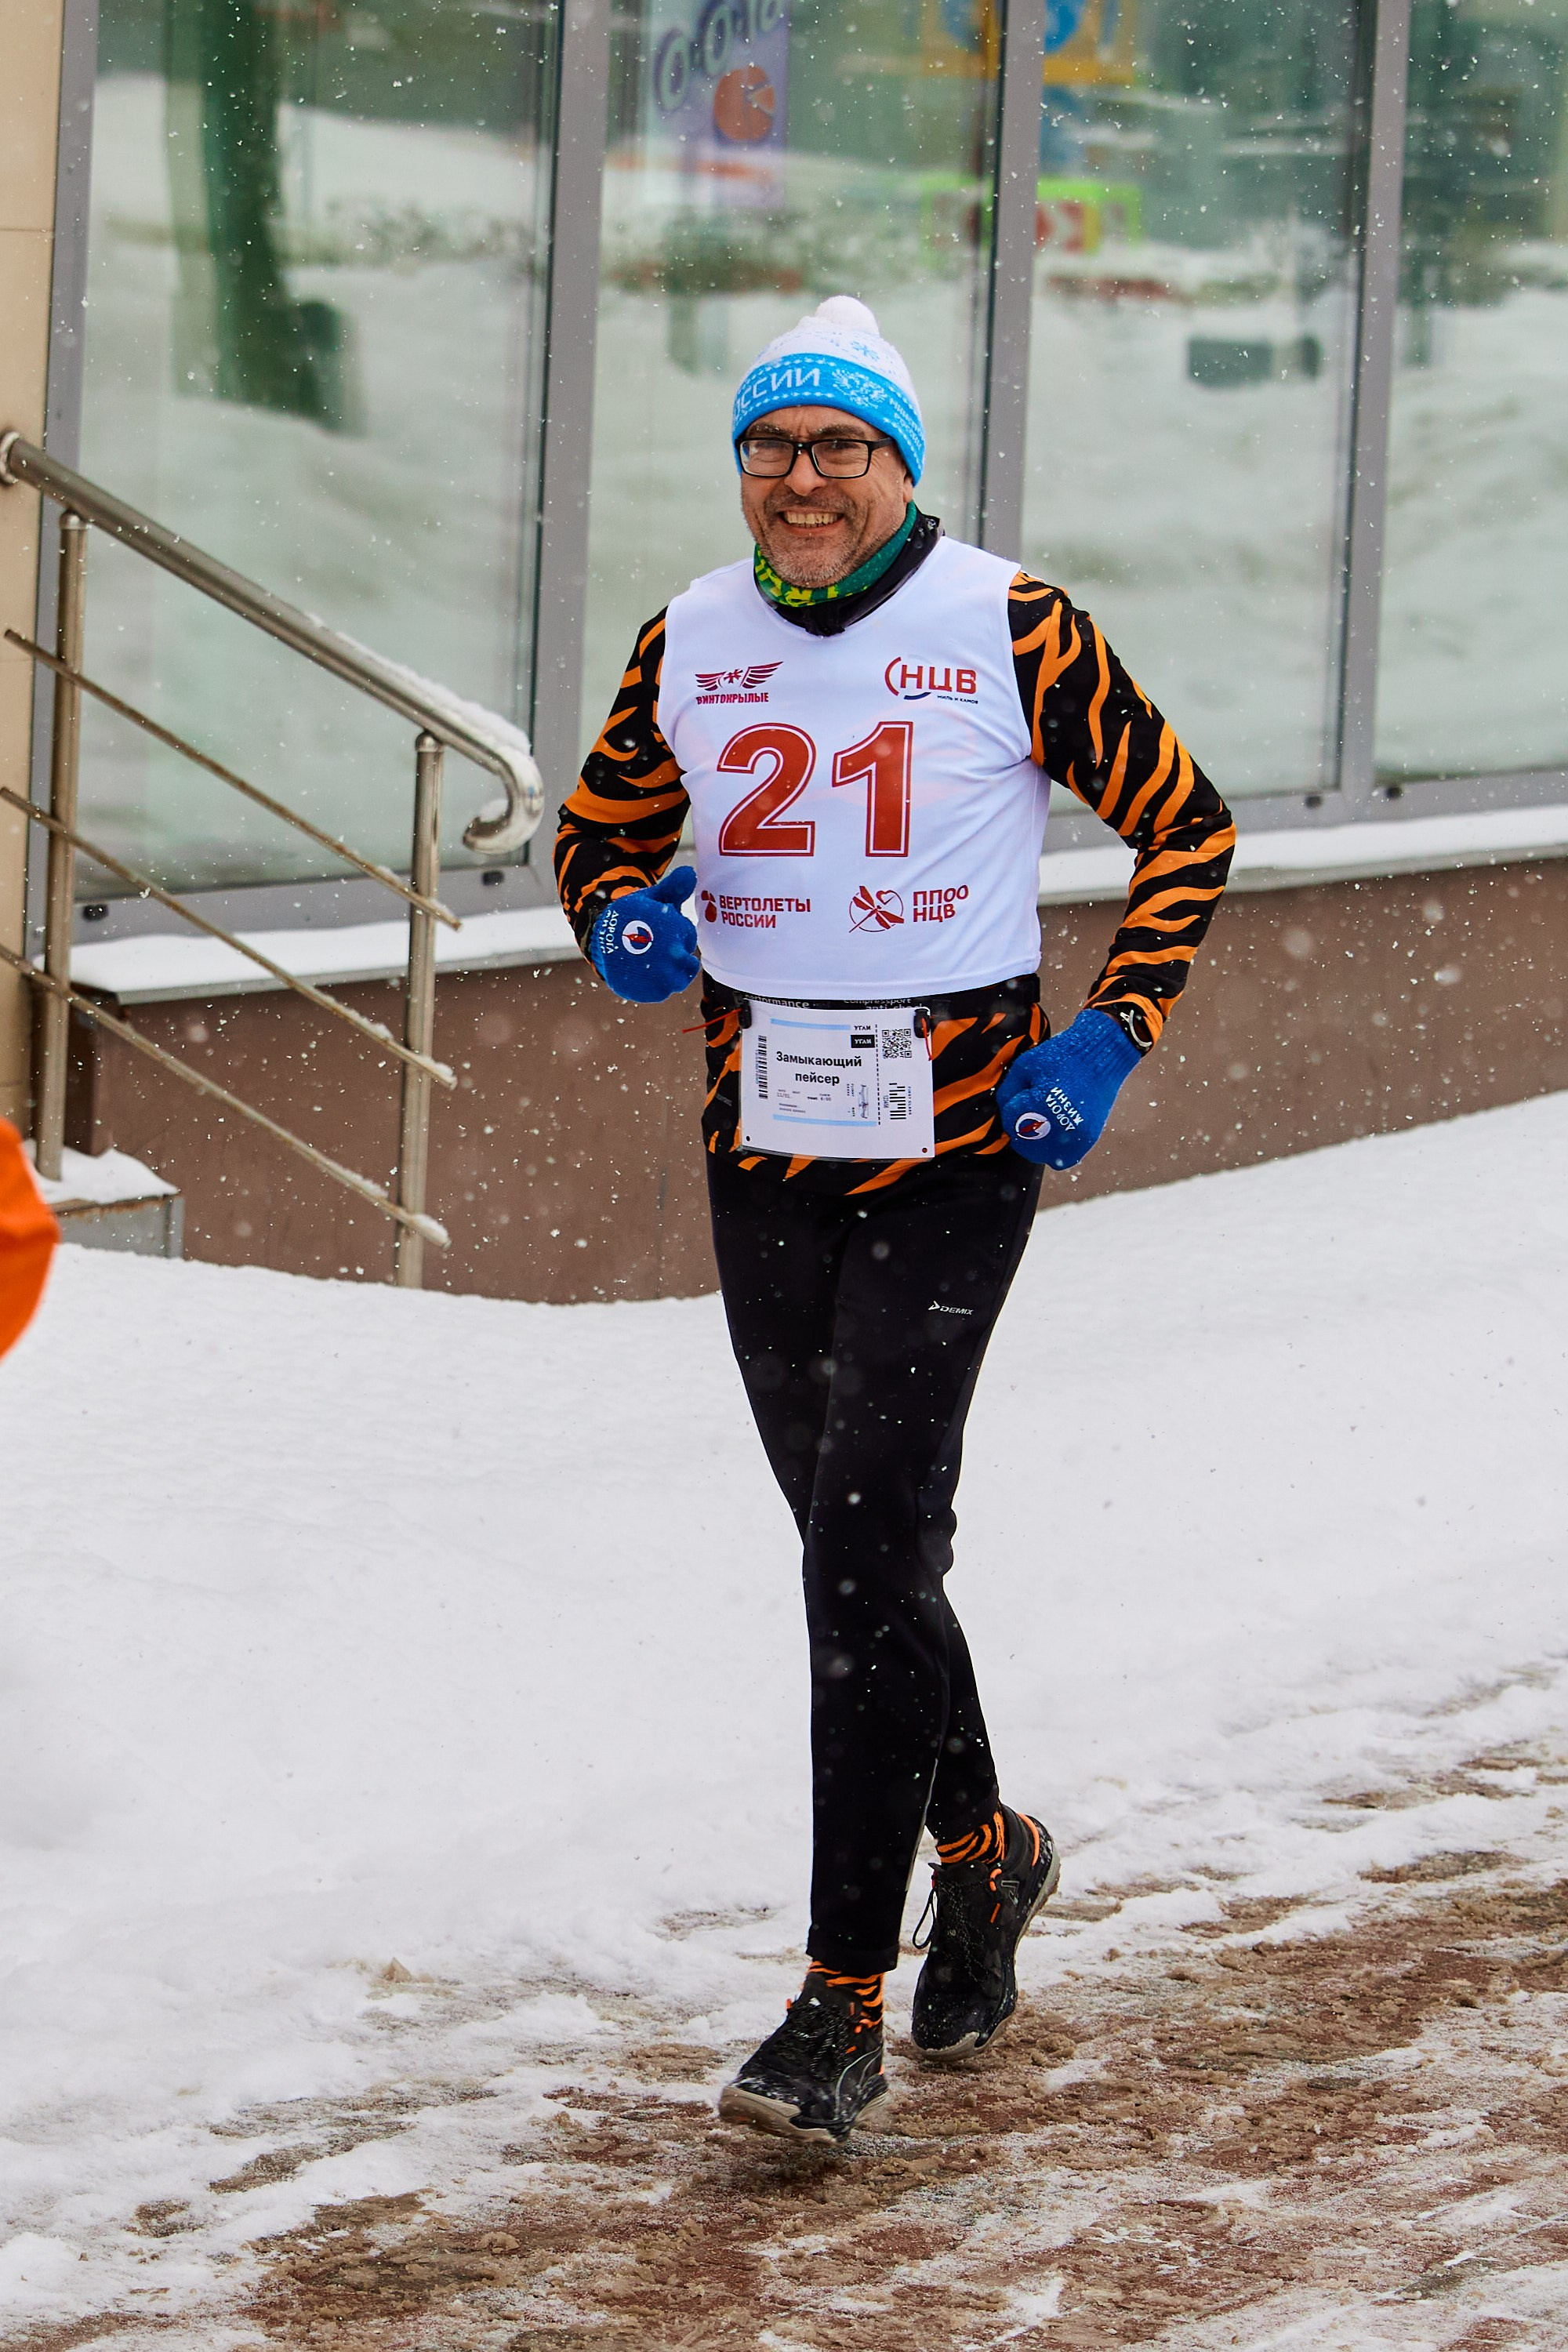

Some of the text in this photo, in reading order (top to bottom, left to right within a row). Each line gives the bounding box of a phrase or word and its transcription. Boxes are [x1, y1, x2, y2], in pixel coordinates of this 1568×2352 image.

[900, 664, 977, 694] НЦВ
[695, 692, 769, 705] ВИНТОКРЫЛЫЕ
[717, 721, 913, 857] 21
[719, 895, 811, 913] ВЕРТОЛЕТЫ
[913, 884, 969, 906] ППОО
[721, 910, 776, 928] РОССИИ
[913, 903, 956, 923] НЦВ
[776, 1051, 862, 1068] Замыкающий
[795, 1072, 840, 1087] пейсер
[1045, 1094, 1076, 1131] ДОРОГА
[1051, 1087, 1084, 1126] ЖИЗНИ
[940, 1305, 974, 1316] DEMIX
